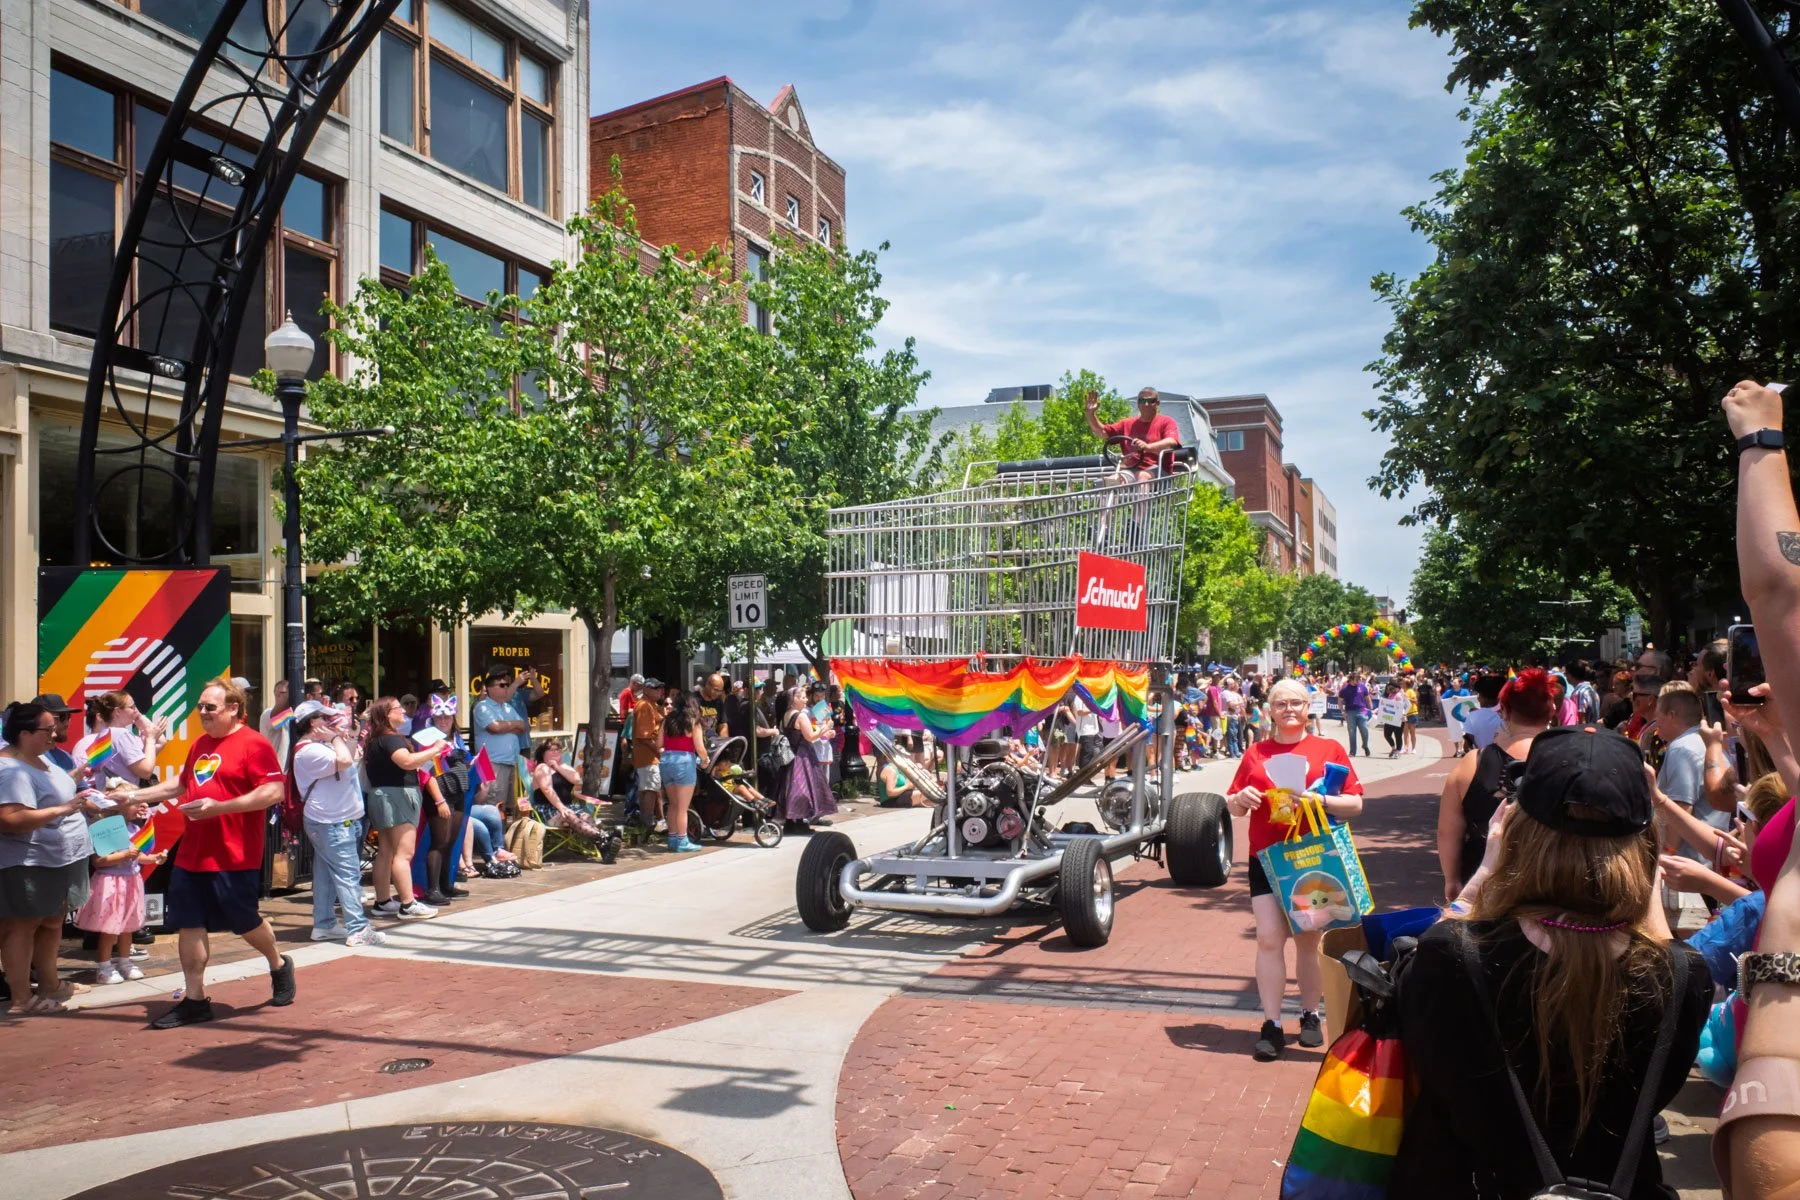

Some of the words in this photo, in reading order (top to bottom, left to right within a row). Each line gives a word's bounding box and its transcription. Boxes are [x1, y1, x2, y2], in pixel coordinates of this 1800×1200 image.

[731, 580, 763, 589] SPEED
[735, 592, 759, 600] LIMIT
[736, 603, 760, 623] 10
[309, 643, 354, 656] AMOUS
[492, 646, 530, 656] PROPER
[1283, 843, 1325, 861] PRECIOUS
[1294, 856, 1321, 870] CARGO
[402, 1124, 661, 1164] EVANSVILLE
